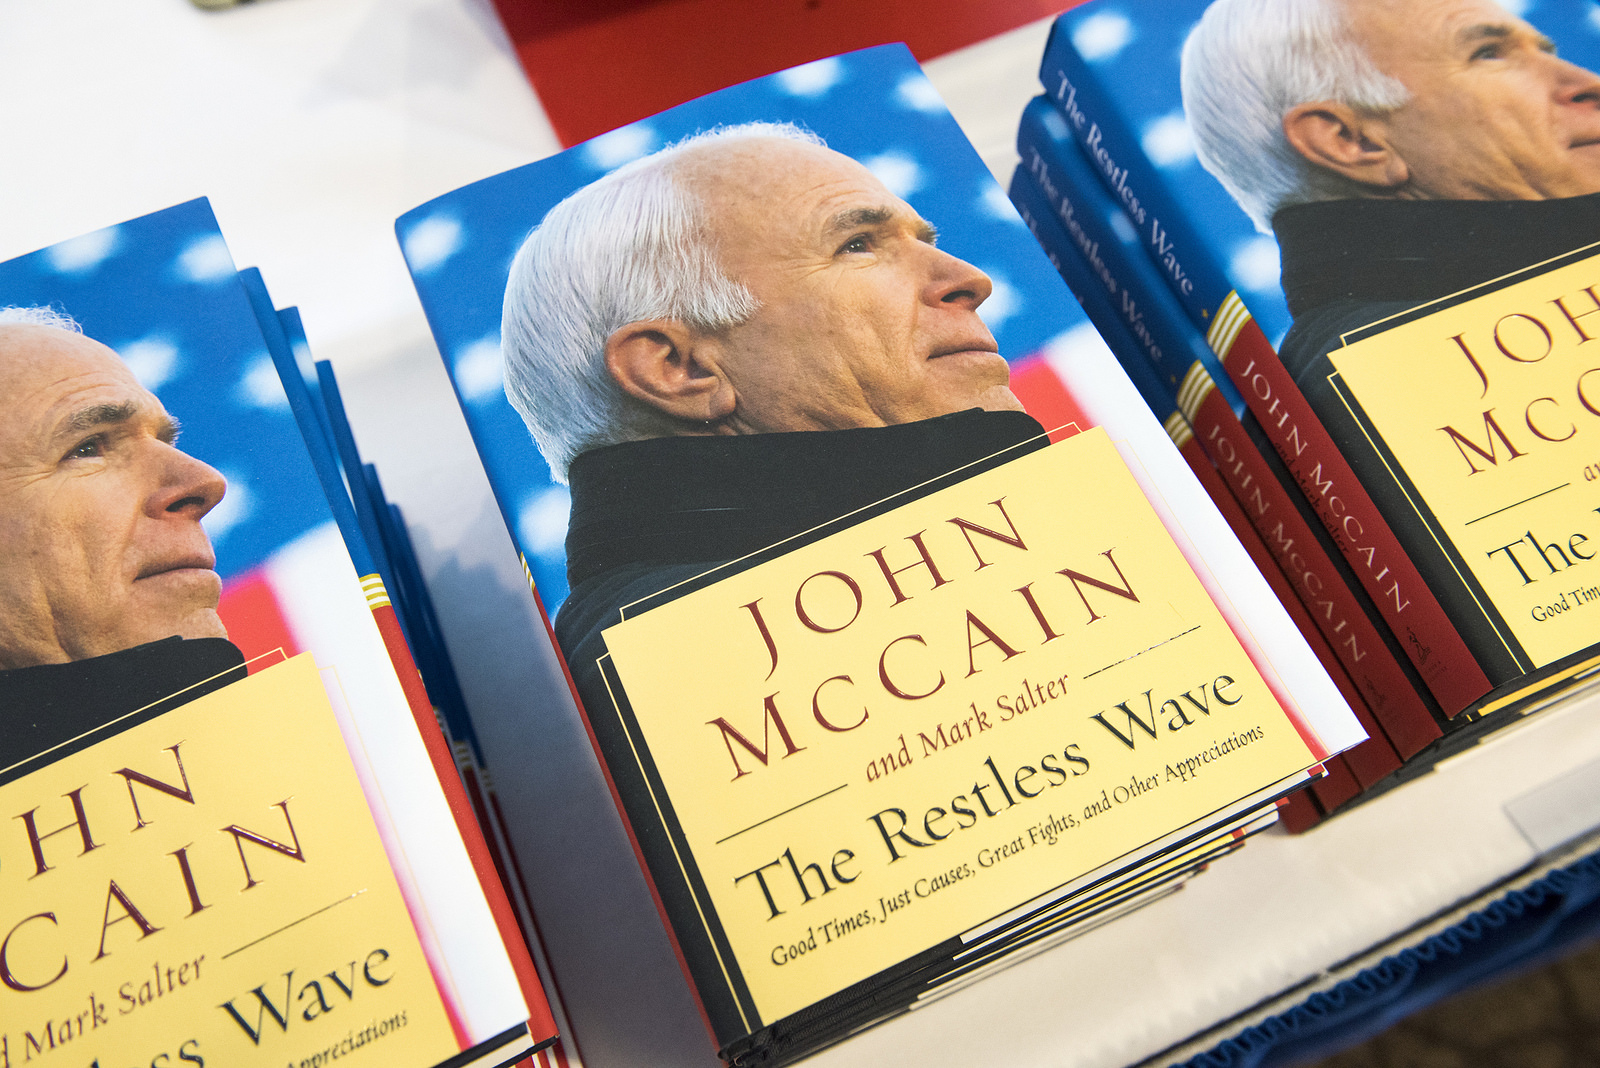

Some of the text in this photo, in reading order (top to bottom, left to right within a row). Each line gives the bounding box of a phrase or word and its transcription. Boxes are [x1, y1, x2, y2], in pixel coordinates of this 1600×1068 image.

[1056, 70, 1194, 296] The Restless Wave
[1239, 360, 1308, 457] JOHN
[1208, 424, 1270, 515] JOHN
[739, 495, 1028, 682] JOHN
[1486, 529, 1598, 587] The
[1531, 592, 1571, 623] Good
[866, 674, 1069, 783] and Mark Salter
[0, 740, 196, 881] HN
[732, 673, 1244, 923] The Restless Wave
[770, 725, 1265, 967] Good Times, Just Causes, Great Fights, and Other Appreciations
[23, 991, 109, 1064] Mark
[117, 954, 206, 1016] Salter
[215, 947, 397, 1047] Wave
